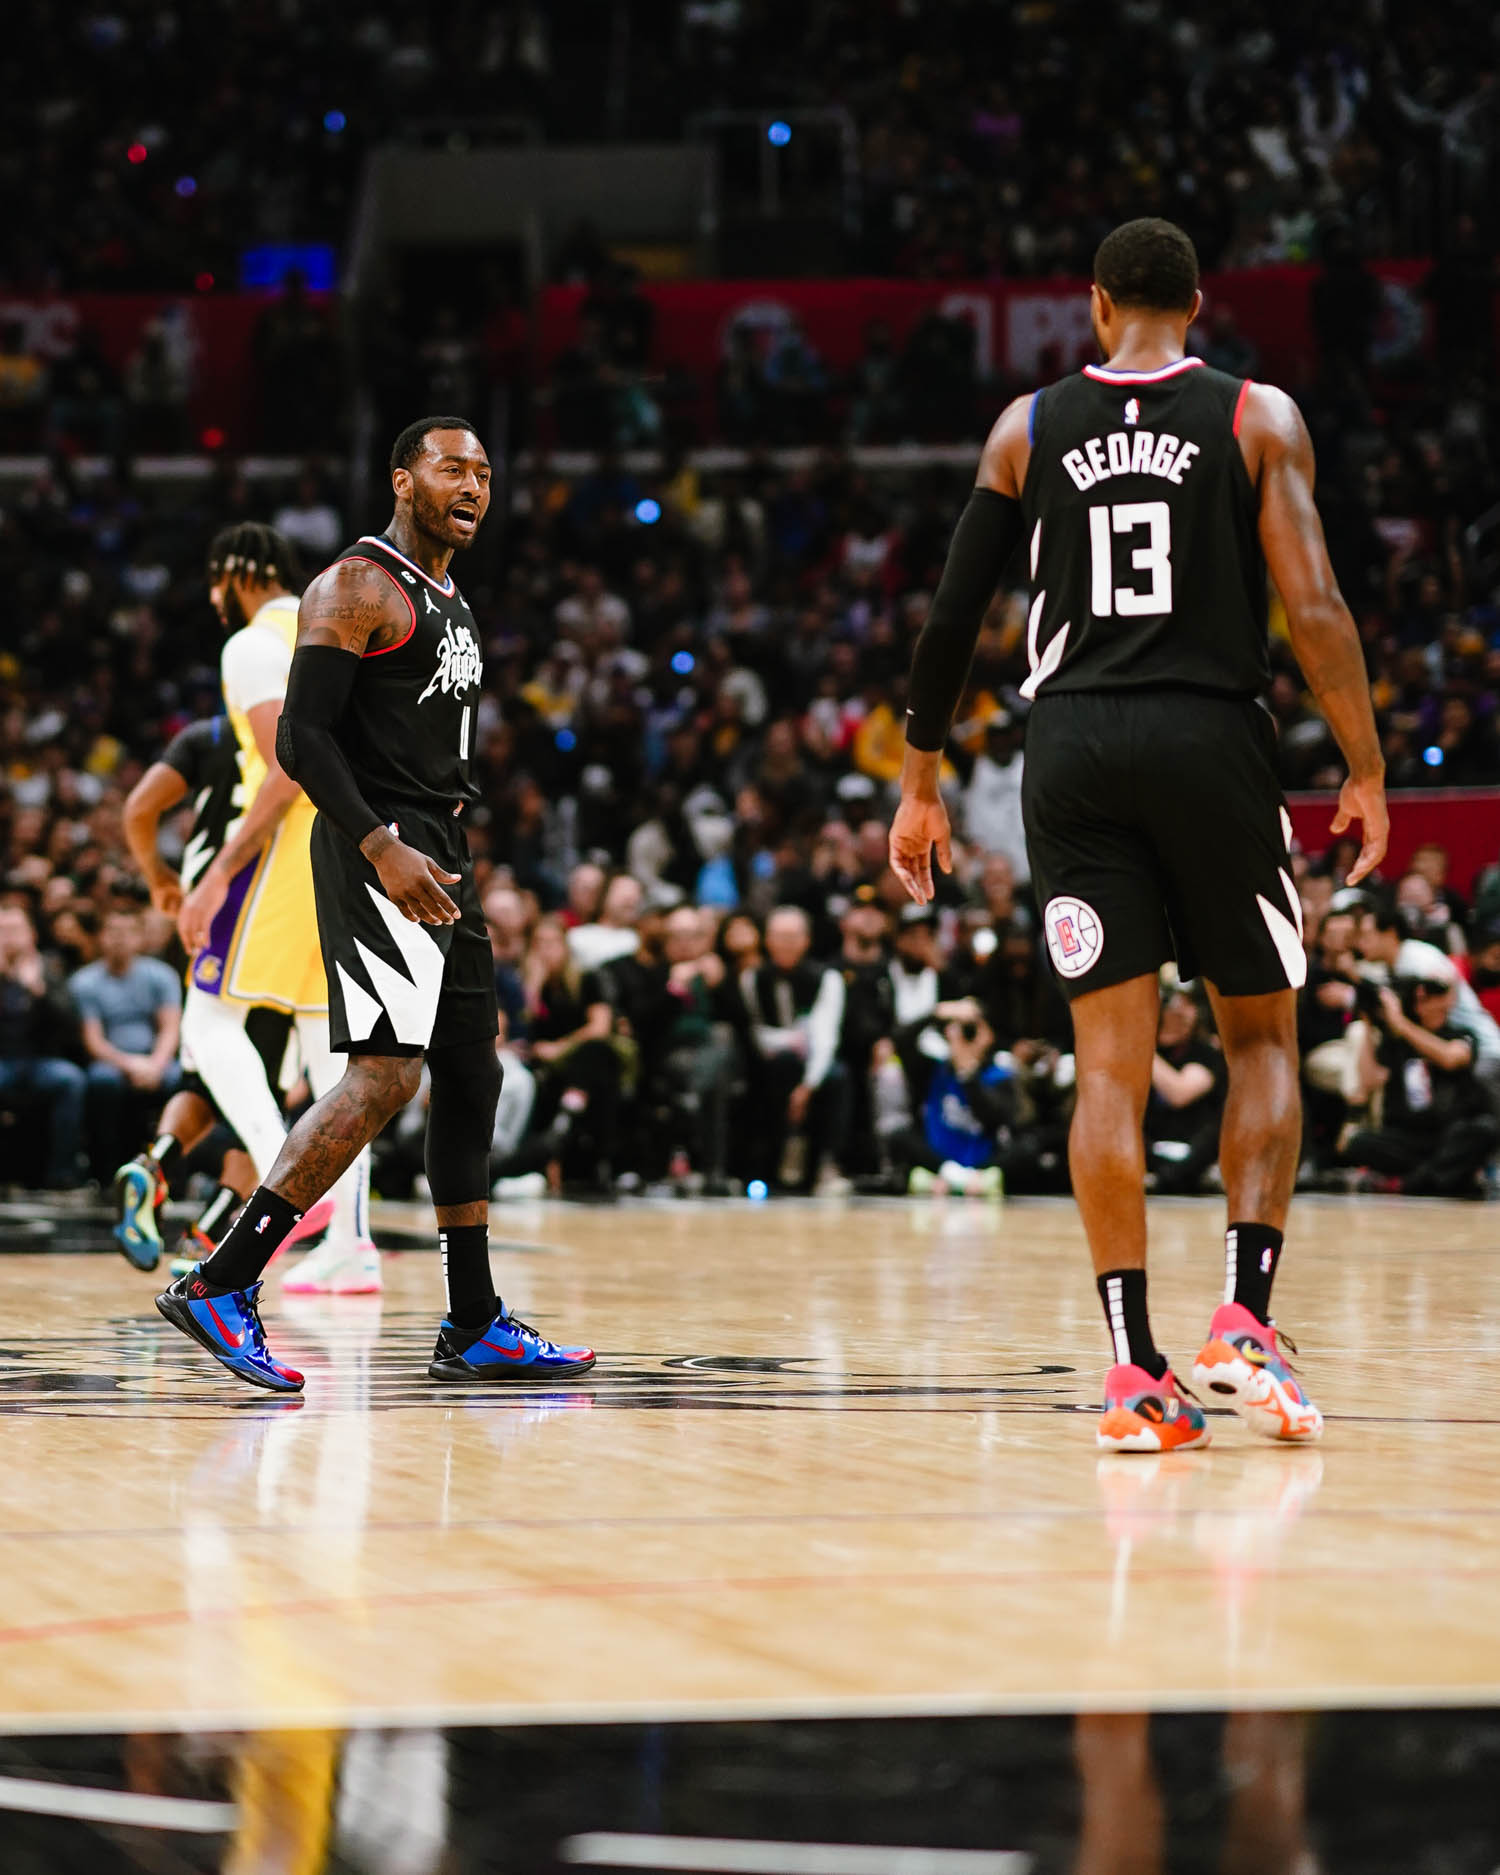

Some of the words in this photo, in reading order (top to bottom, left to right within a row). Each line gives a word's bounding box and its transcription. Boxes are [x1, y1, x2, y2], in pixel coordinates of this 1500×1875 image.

[1061, 431, 1200, 491] GEORGE
[1089, 501, 1172, 617] 13
[460, 705, 471, 760] 1
